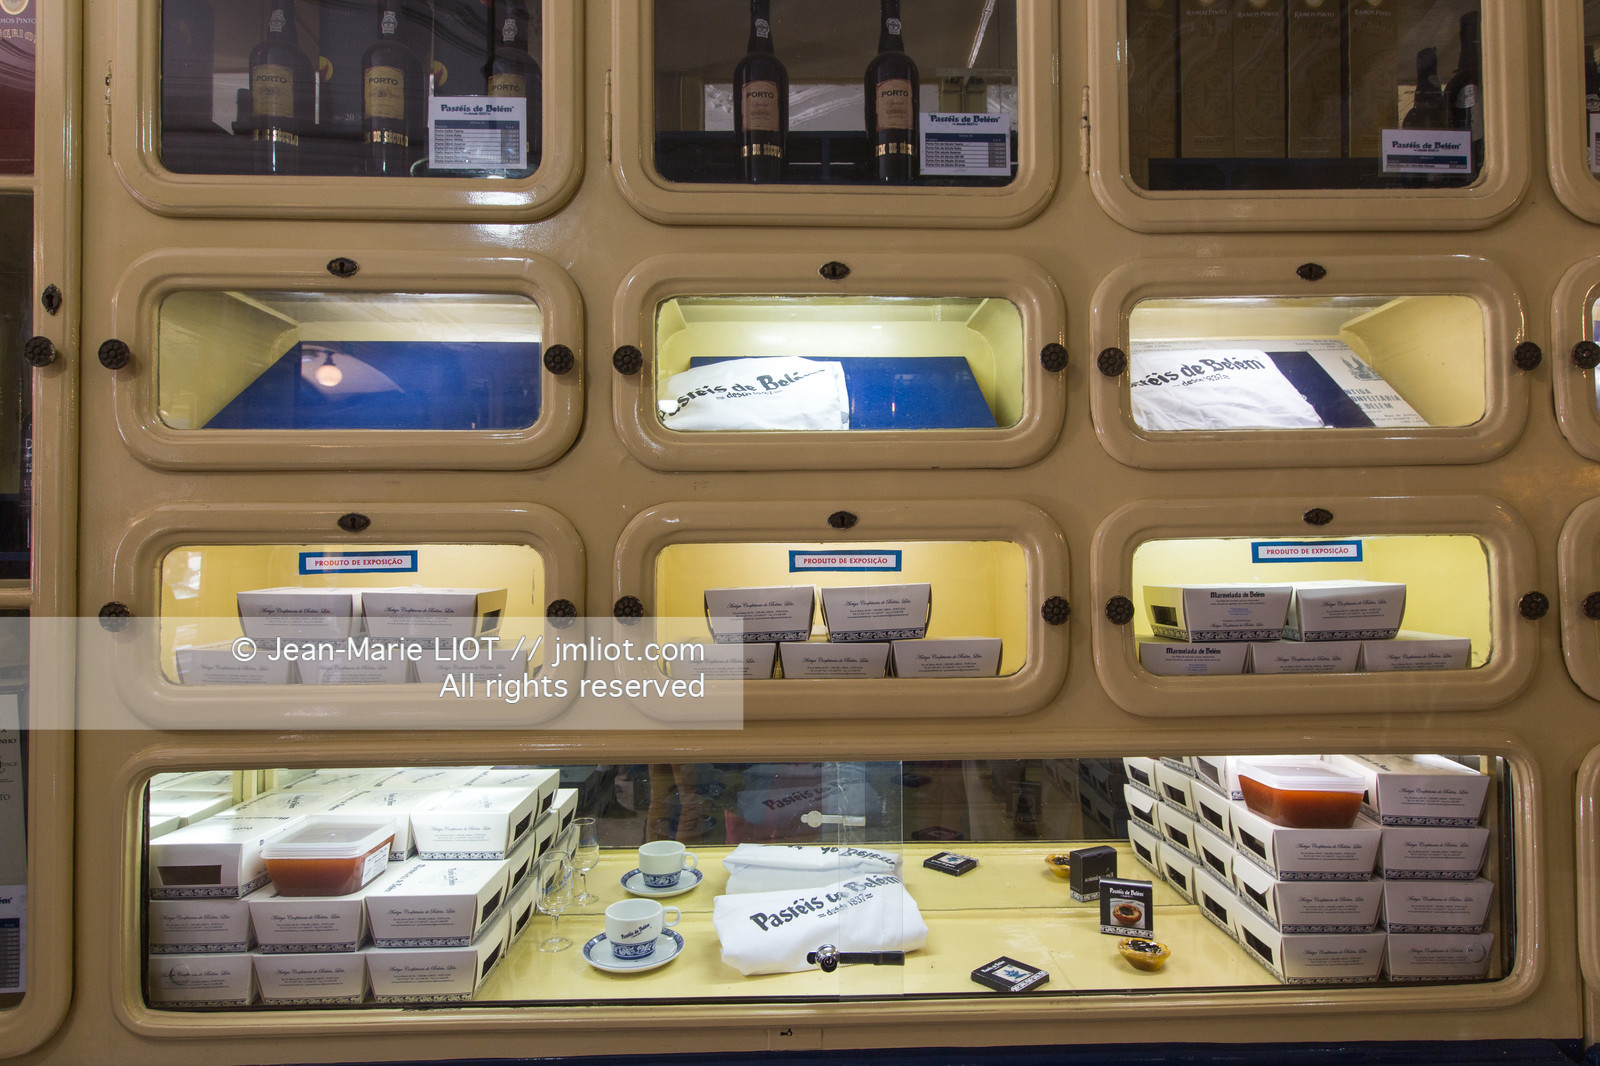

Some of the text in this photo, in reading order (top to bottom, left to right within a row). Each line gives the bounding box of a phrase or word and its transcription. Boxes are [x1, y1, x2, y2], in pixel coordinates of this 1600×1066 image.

[256, 74, 288, 84] PORTO
[368, 77, 399, 86] PORTO
[492, 84, 521, 92] PORTO
[440, 104, 471, 112] Pastéis
[930, 114, 960, 122] Pastéis
[1392, 141, 1420, 149] Pastéis
[1180, 362, 1205, 378] de
[1199, 357, 1266, 372] Belém
[732, 382, 756, 392] de
[1312, 546, 1348, 555] EXPOSIÇÃO
[363, 556, 402, 566] EXPOSIÇÃO
[850, 556, 888, 565] EXPOSIÇÃO
[750, 896, 824, 932] Pastéis
[843, 875, 900, 892] Belém
[848, 894, 866, 906] 1837
